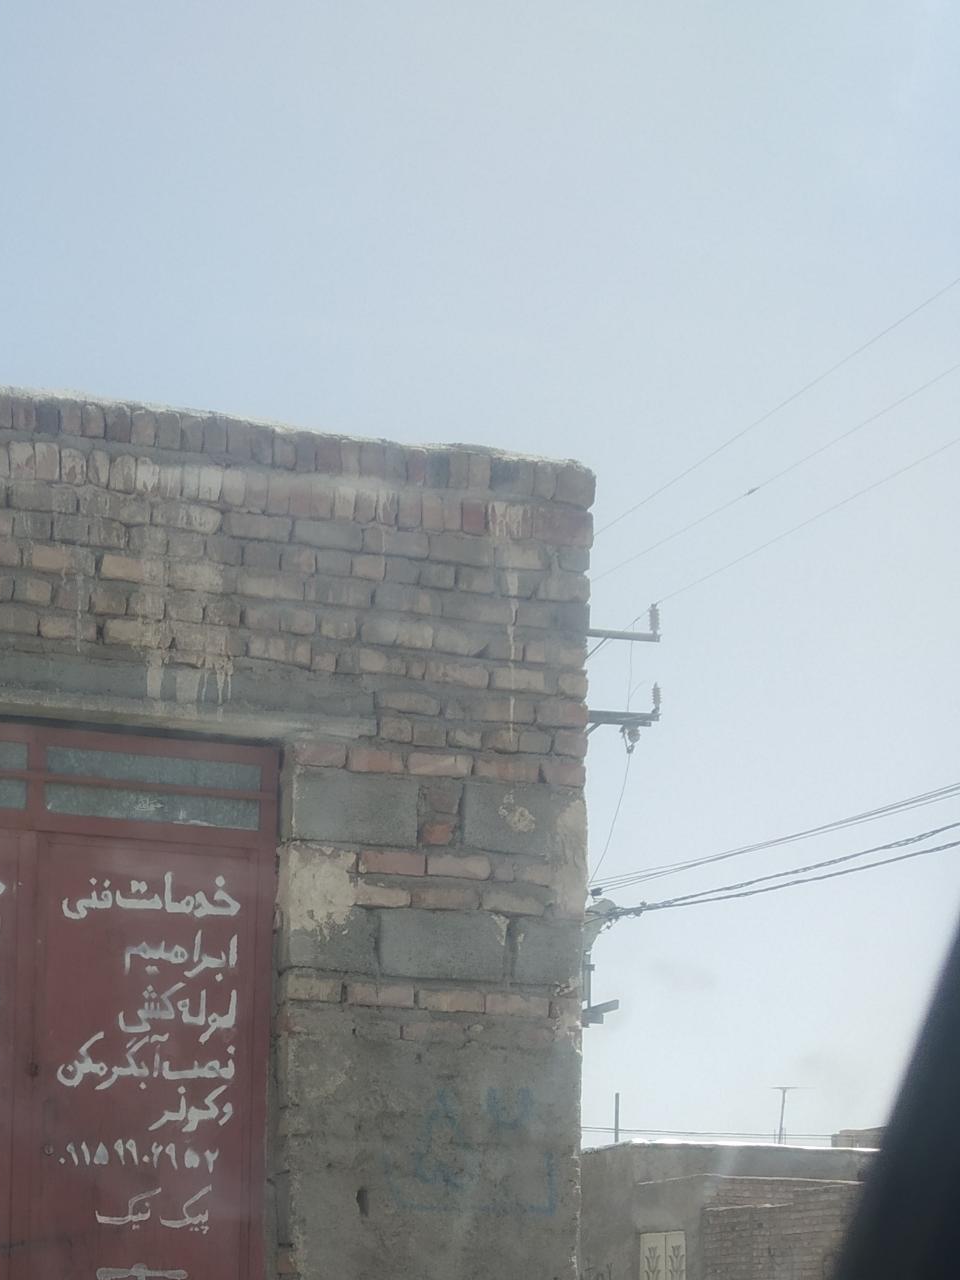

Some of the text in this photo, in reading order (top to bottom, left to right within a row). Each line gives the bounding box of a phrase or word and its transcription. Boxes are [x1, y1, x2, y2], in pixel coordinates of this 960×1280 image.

[62, 871, 240, 919] خدمات فنی
[124, 929, 237, 982] ابراهیم
